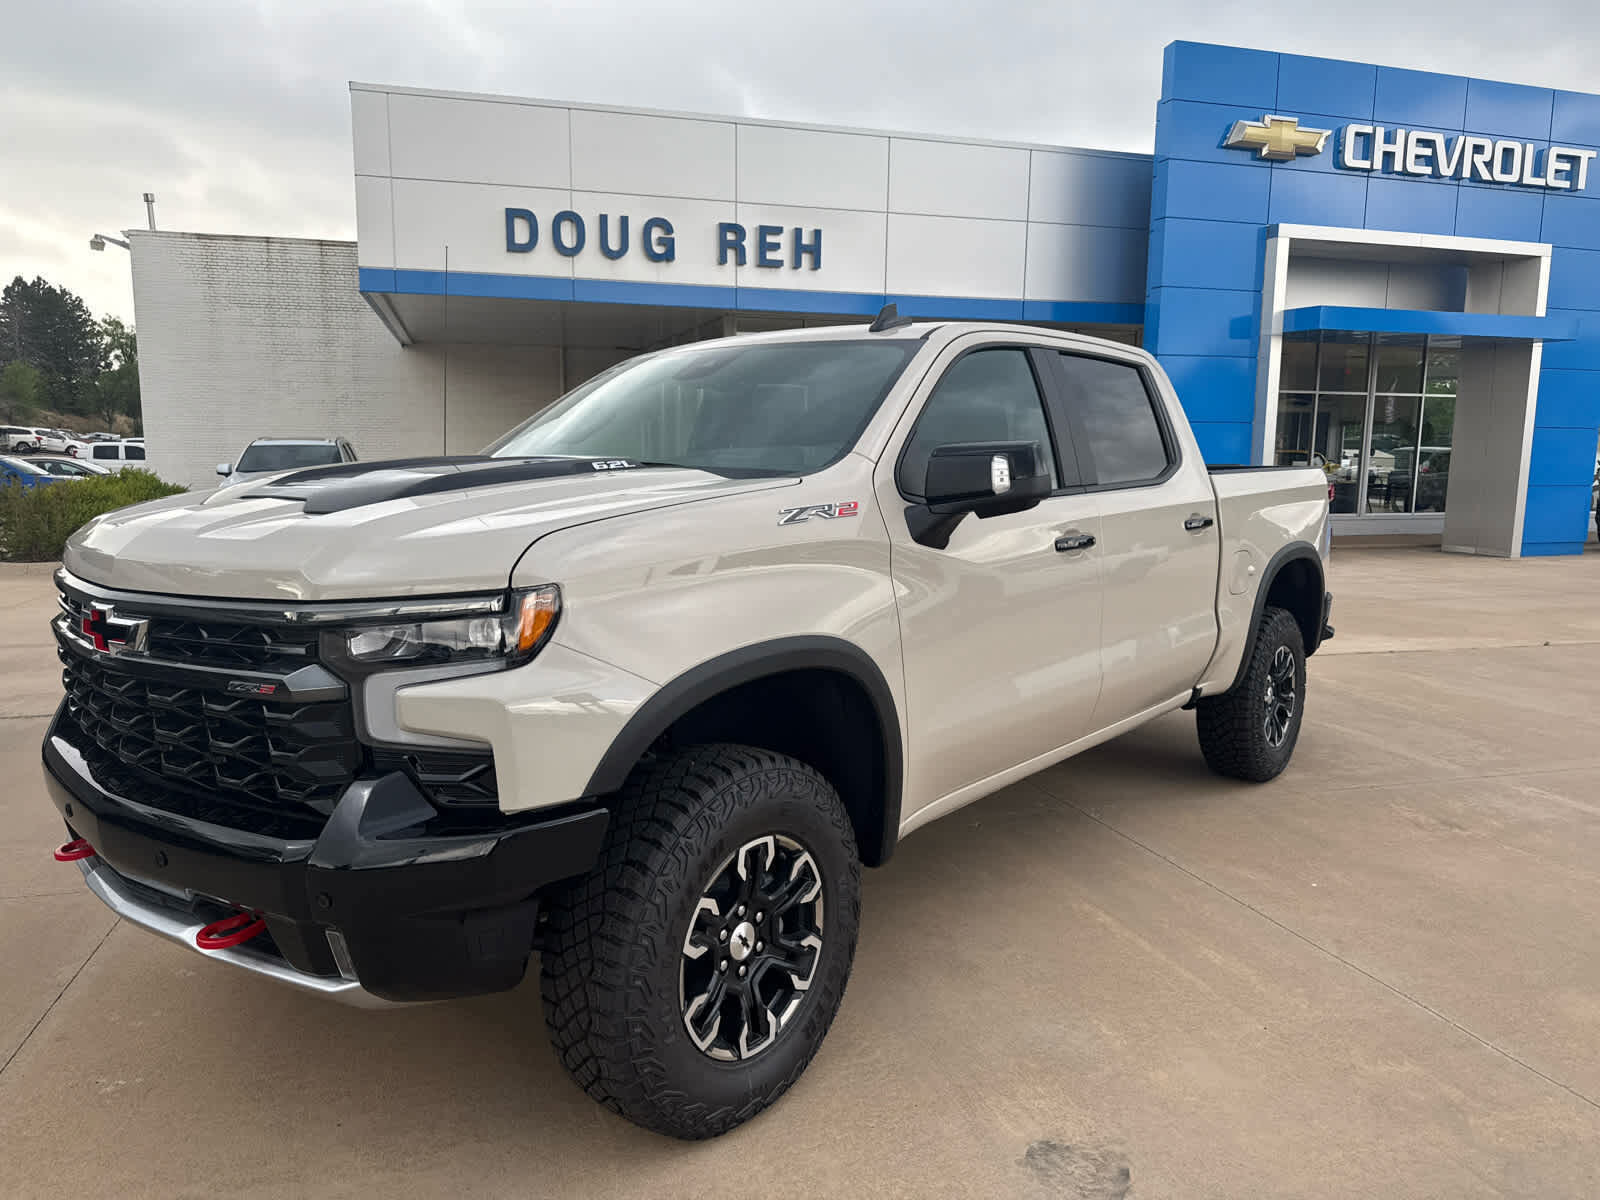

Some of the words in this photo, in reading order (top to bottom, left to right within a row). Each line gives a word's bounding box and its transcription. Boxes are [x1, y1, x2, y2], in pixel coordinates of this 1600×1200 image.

[1339, 123, 1598, 191] CHEVROLET
[504, 207, 676, 263] DOUG
[717, 221, 823, 270] REH
[777, 501, 859, 526] ZR2
